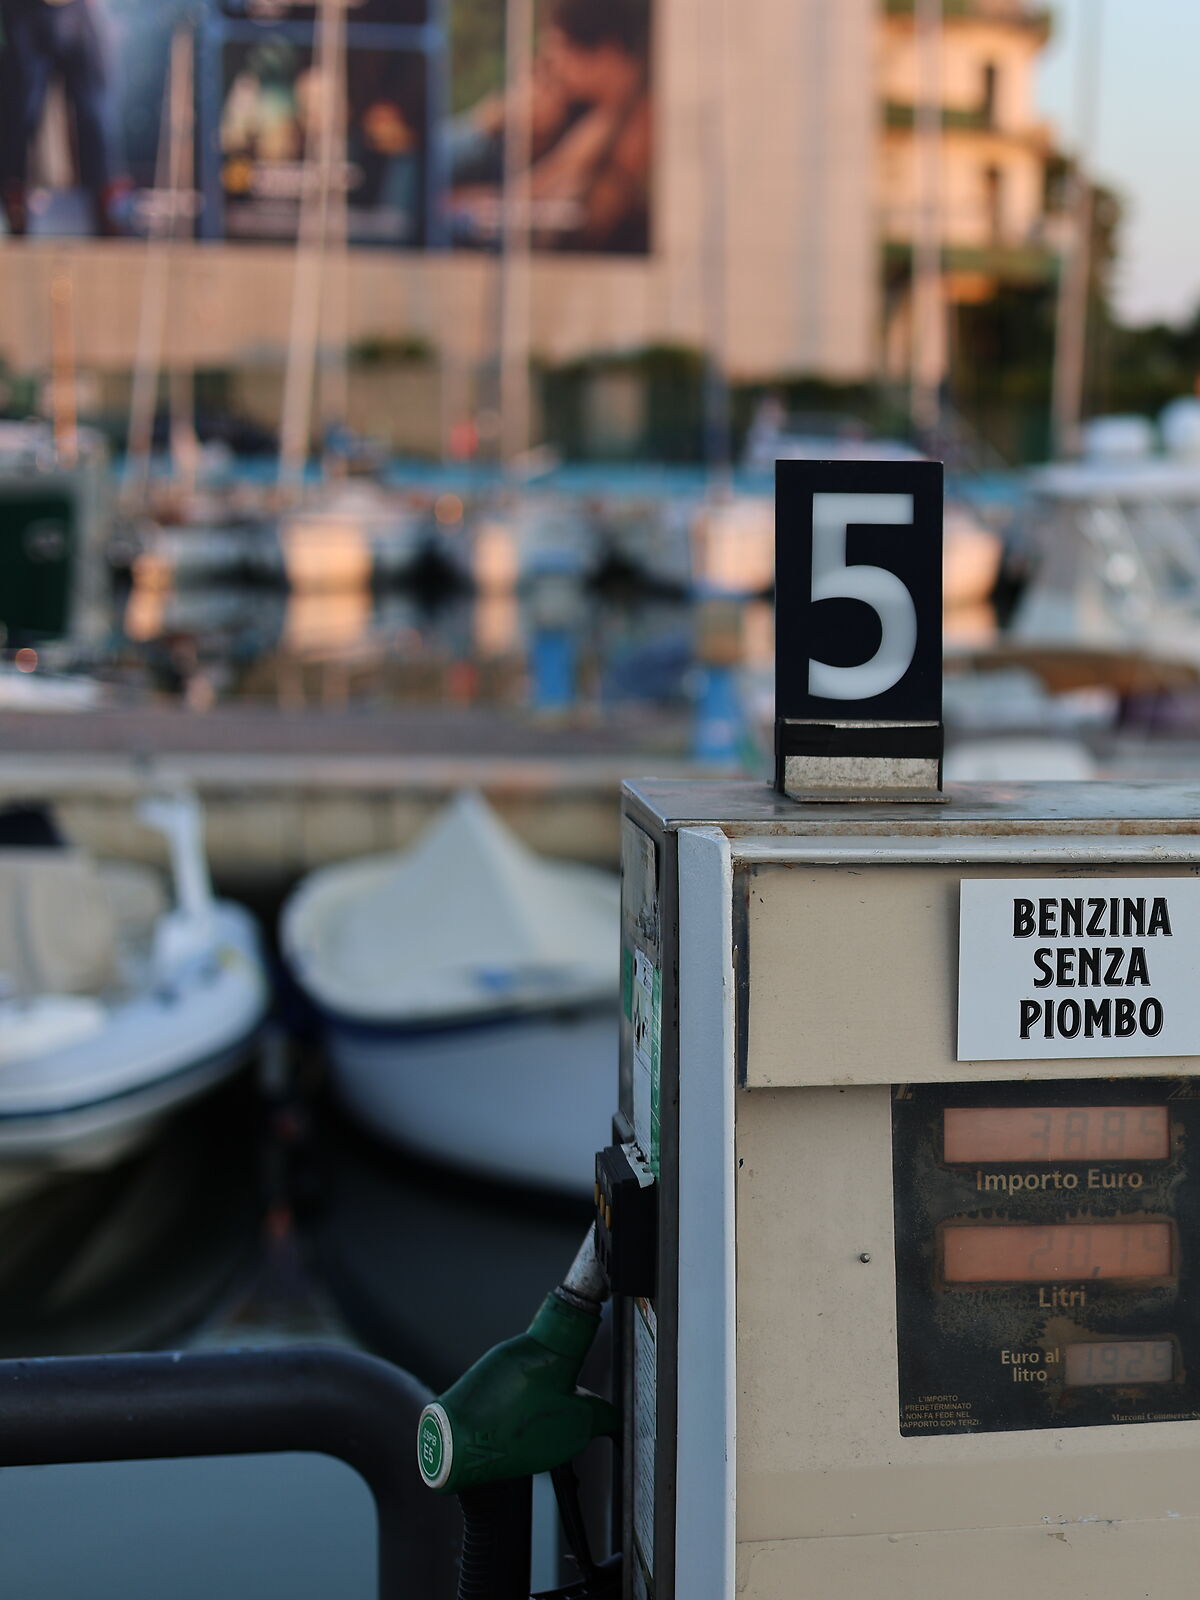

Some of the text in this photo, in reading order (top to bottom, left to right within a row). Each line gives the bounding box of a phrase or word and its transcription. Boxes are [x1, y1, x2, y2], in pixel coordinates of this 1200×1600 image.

[808, 493, 918, 701] 5
[1013, 897, 1173, 938] BENZINA
[1033, 947, 1151, 988] SENZA
[1019, 997, 1164, 1040] PIOMBO
[976, 1169, 1143, 1195] Importo Euro
[1039, 1286, 1086, 1308] Litri
[1001, 1348, 1060, 1365] Euro al
[1013, 1367, 1048, 1383] litro
[905, 1403, 972, 1411] PREDETERMINATO
[1111, 1413, 1145, 1421] Marconi
[423, 1442, 434, 1464] E5
